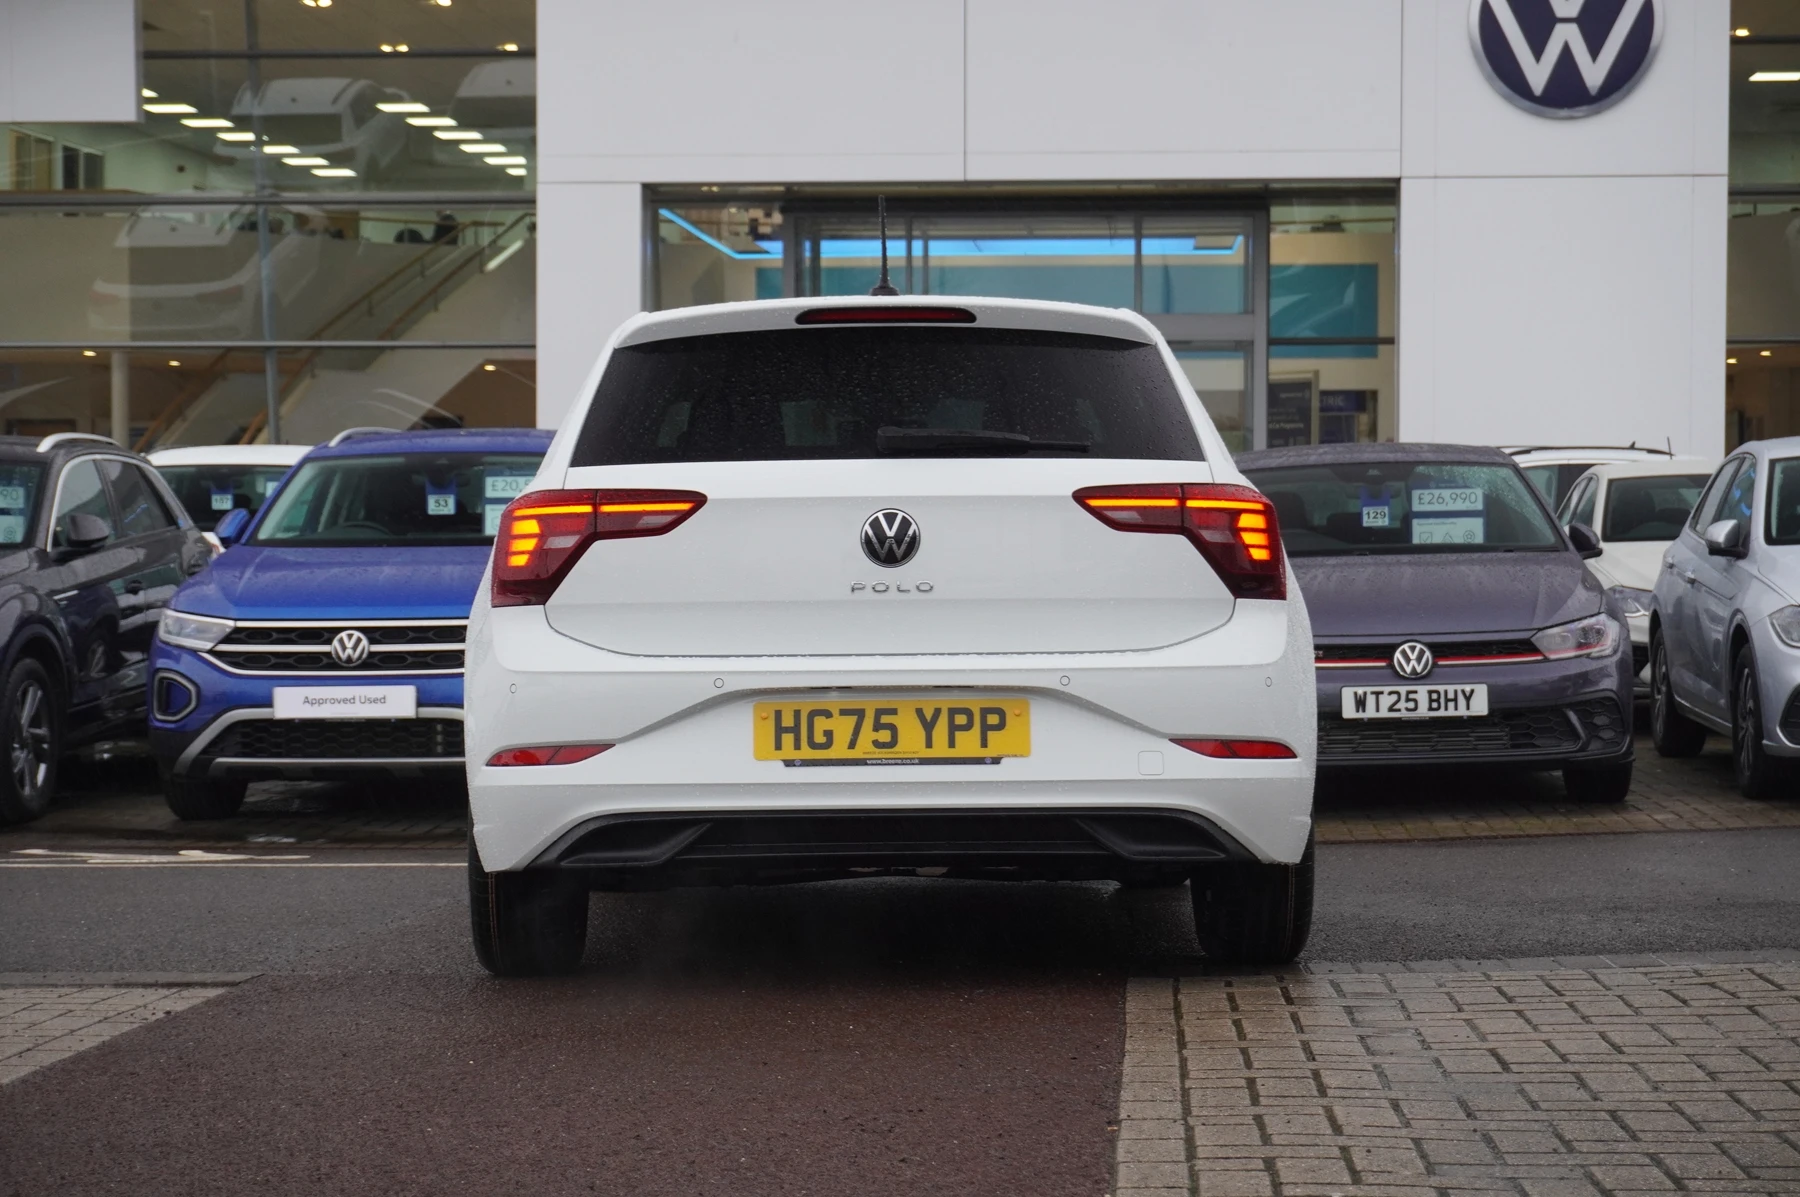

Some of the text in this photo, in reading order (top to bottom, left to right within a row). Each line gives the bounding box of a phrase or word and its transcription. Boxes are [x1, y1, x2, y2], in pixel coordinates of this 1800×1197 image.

[1484, 0, 1648, 97] W
[434, 498, 448, 508] 53
[1417, 491, 1478, 507] £26,990
[1364, 510, 1386, 520] 129
[851, 580, 934, 593] POLO
[302, 695, 386, 707] Approved Used
[1353, 688, 1475, 713] WT25 BHY
[774, 706, 1007, 751] HG75 YPP
